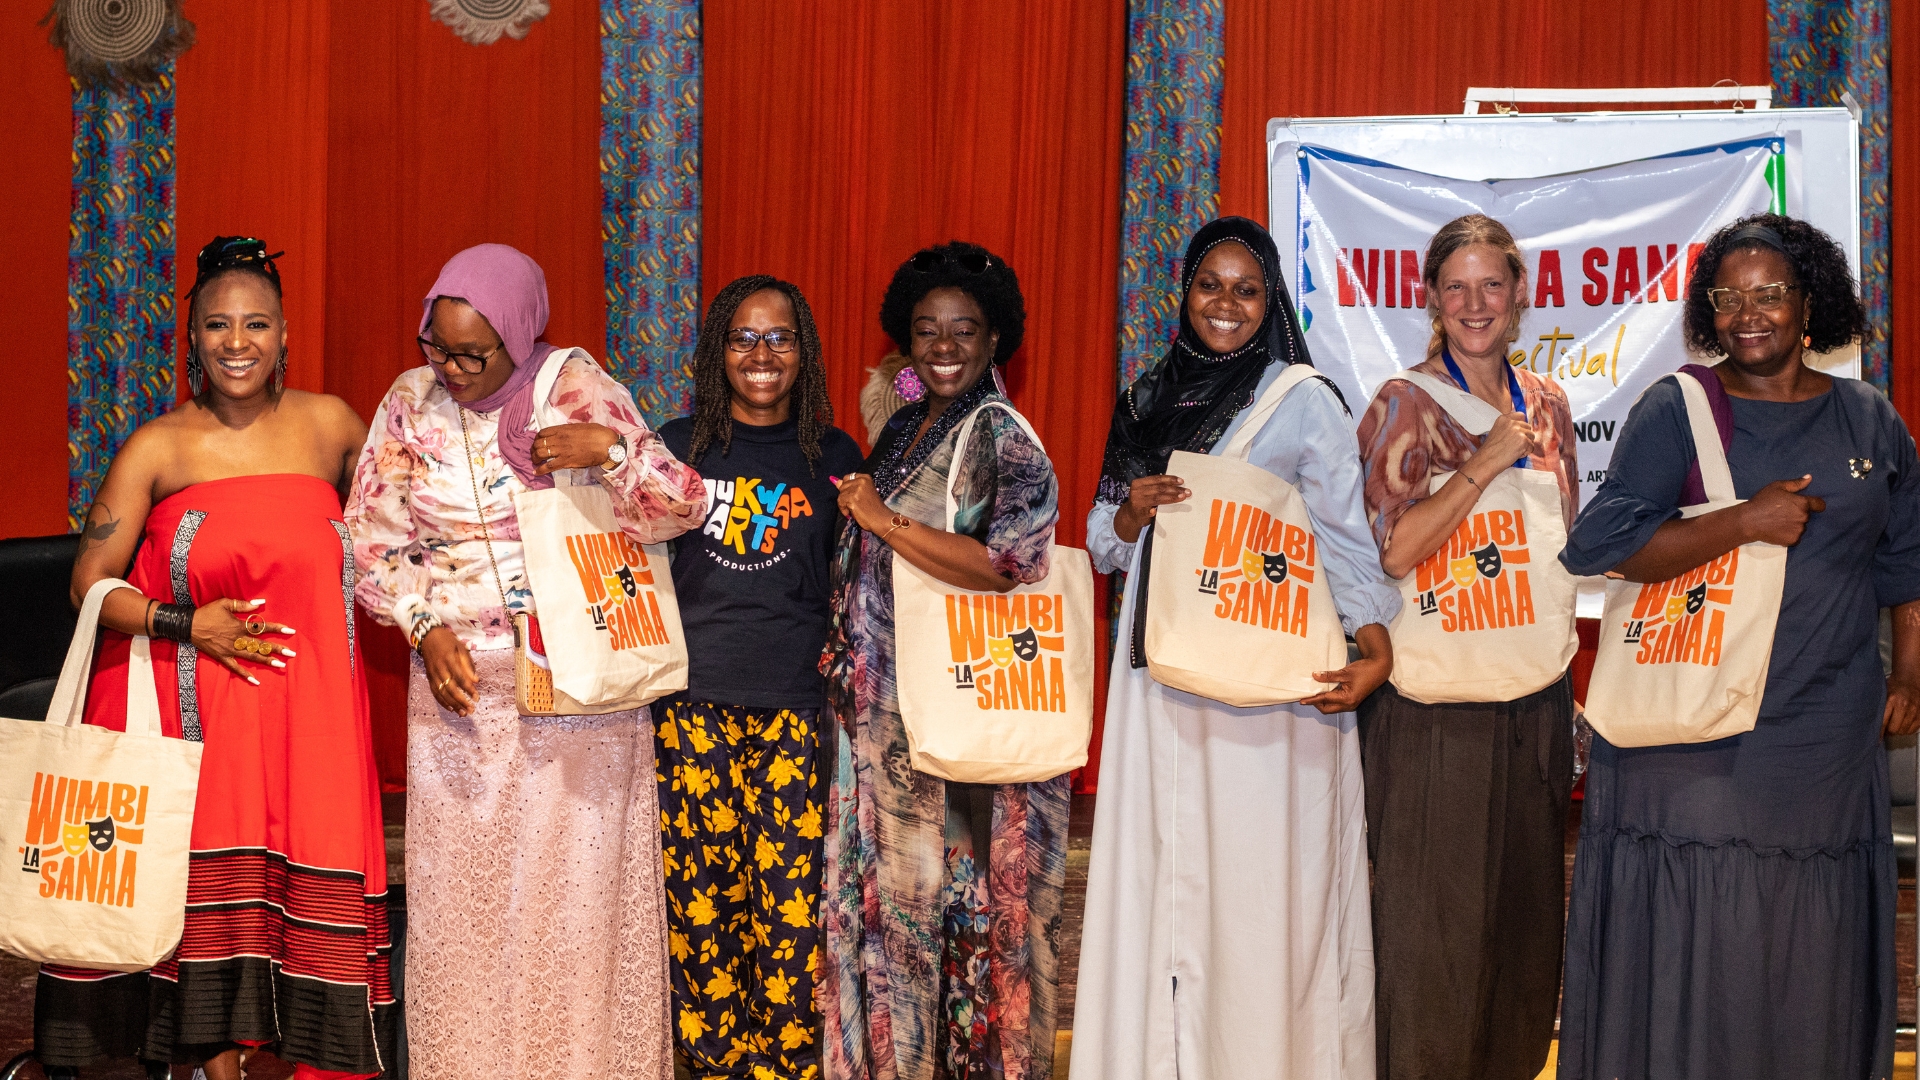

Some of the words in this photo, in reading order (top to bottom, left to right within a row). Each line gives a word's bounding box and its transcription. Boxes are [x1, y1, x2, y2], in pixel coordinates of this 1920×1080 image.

[1336, 248, 1429, 309] WIM
[1505, 324, 1626, 387] estival
[1573, 421, 1616, 442] NOV
[703, 503, 779, 555] ARTS
[1203, 498, 1315, 568] WIMBI
[1200, 569, 1219, 589] LA
[1214, 578, 1309, 638] SANAA
[1420, 590, 1437, 611] LA
[1439, 568, 1536, 633] SANAA
[591, 605, 605, 624] LA
[606, 588, 671, 651] SANAA
[945, 594, 1063, 663] WIMBI
[1626, 621, 1643, 638] LA
[1636, 605, 1725, 667] SANAA
[955, 665, 973, 683] LA
[975, 653, 1066, 713] SANAA
[25, 771, 149, 845] WIMBI
[23, 846, 40, 867] LA
[39, 845, 137, 908] SANAA
